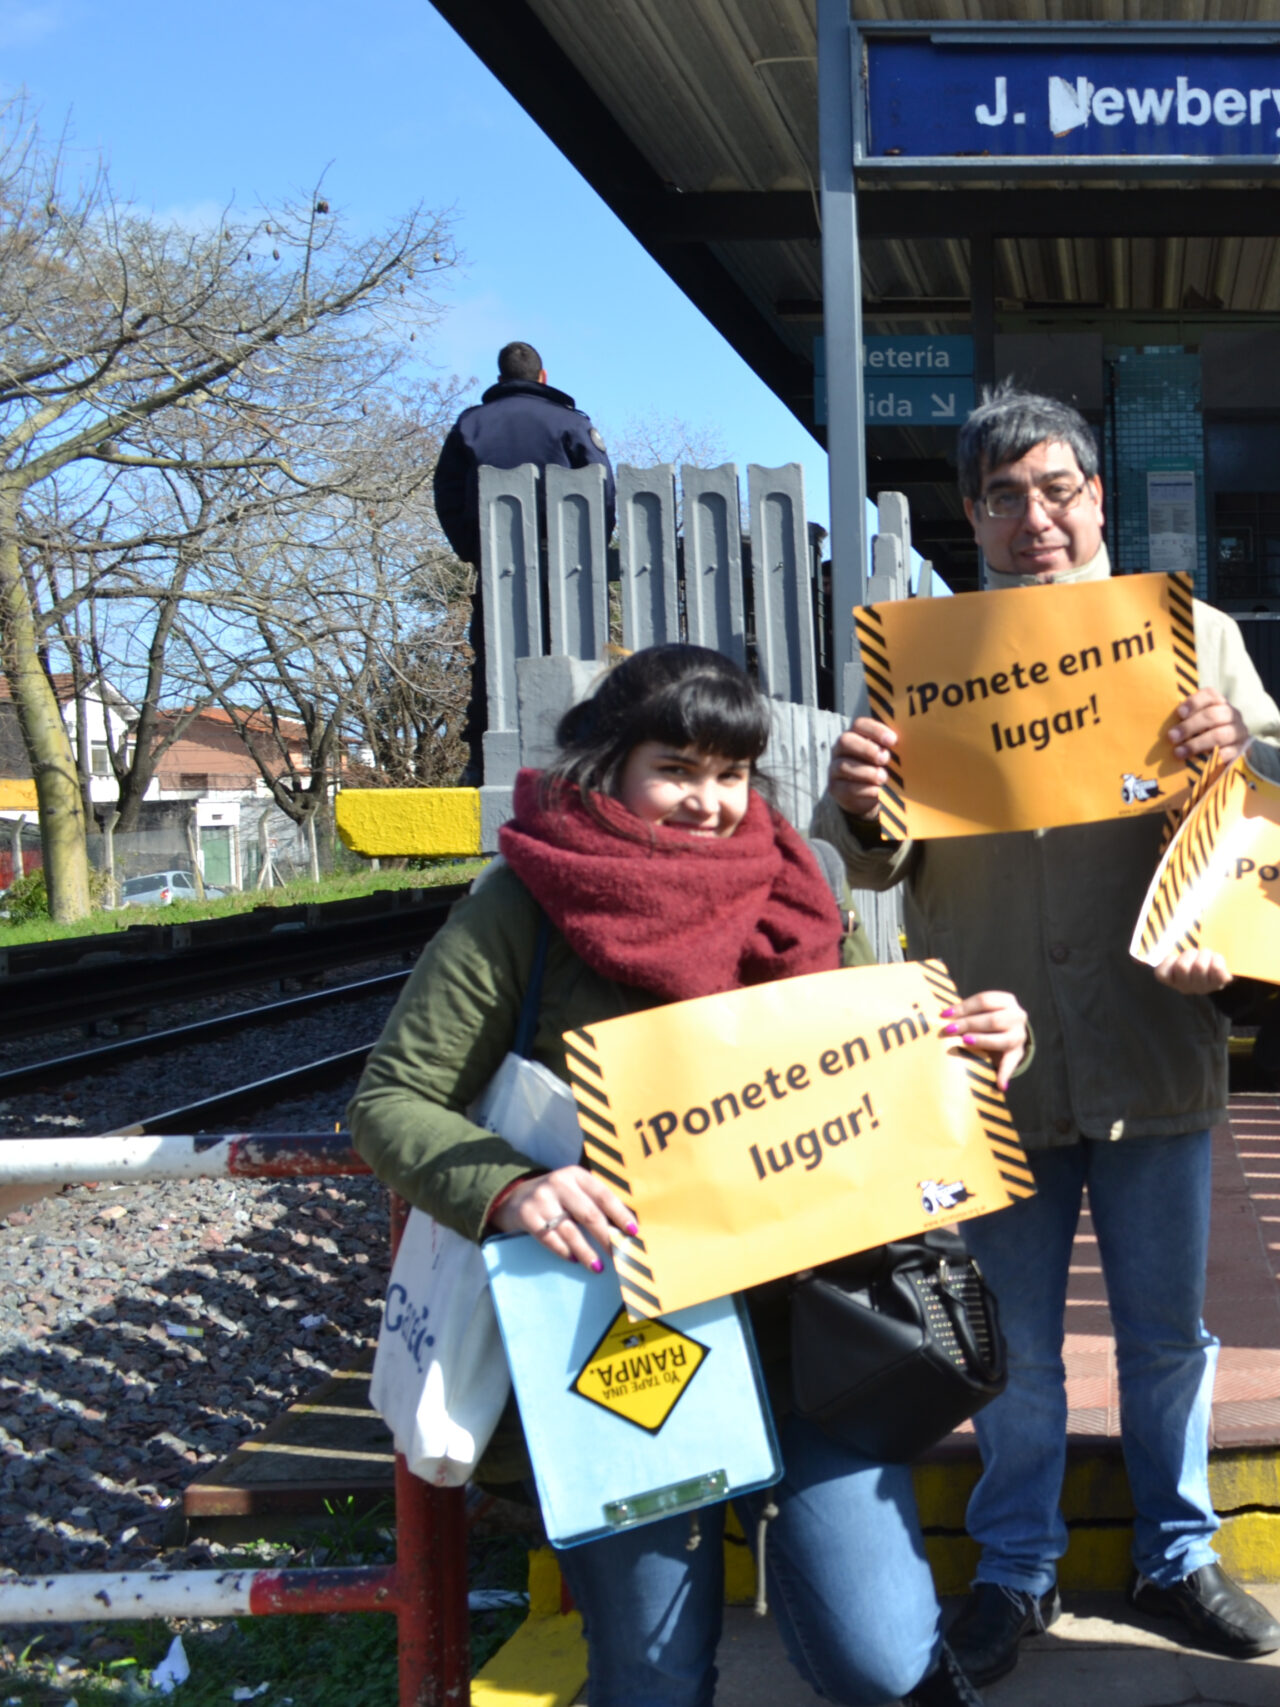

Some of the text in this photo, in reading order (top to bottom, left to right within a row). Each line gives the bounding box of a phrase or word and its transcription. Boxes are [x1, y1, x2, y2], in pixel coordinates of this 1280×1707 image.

[975, 76, 1026, 125] J.
[862, 344, 950, 368] letería
[906, 622, 1156, 717] ¡Ponete en mi
[992, 694, 1102, 753] lugar!
[632, 1003, 931, 1158] ¡Ponete en mi
[749, 1093, 880, 1181] lugar!
[589, 1345, 687, 1387] RAMPA.
